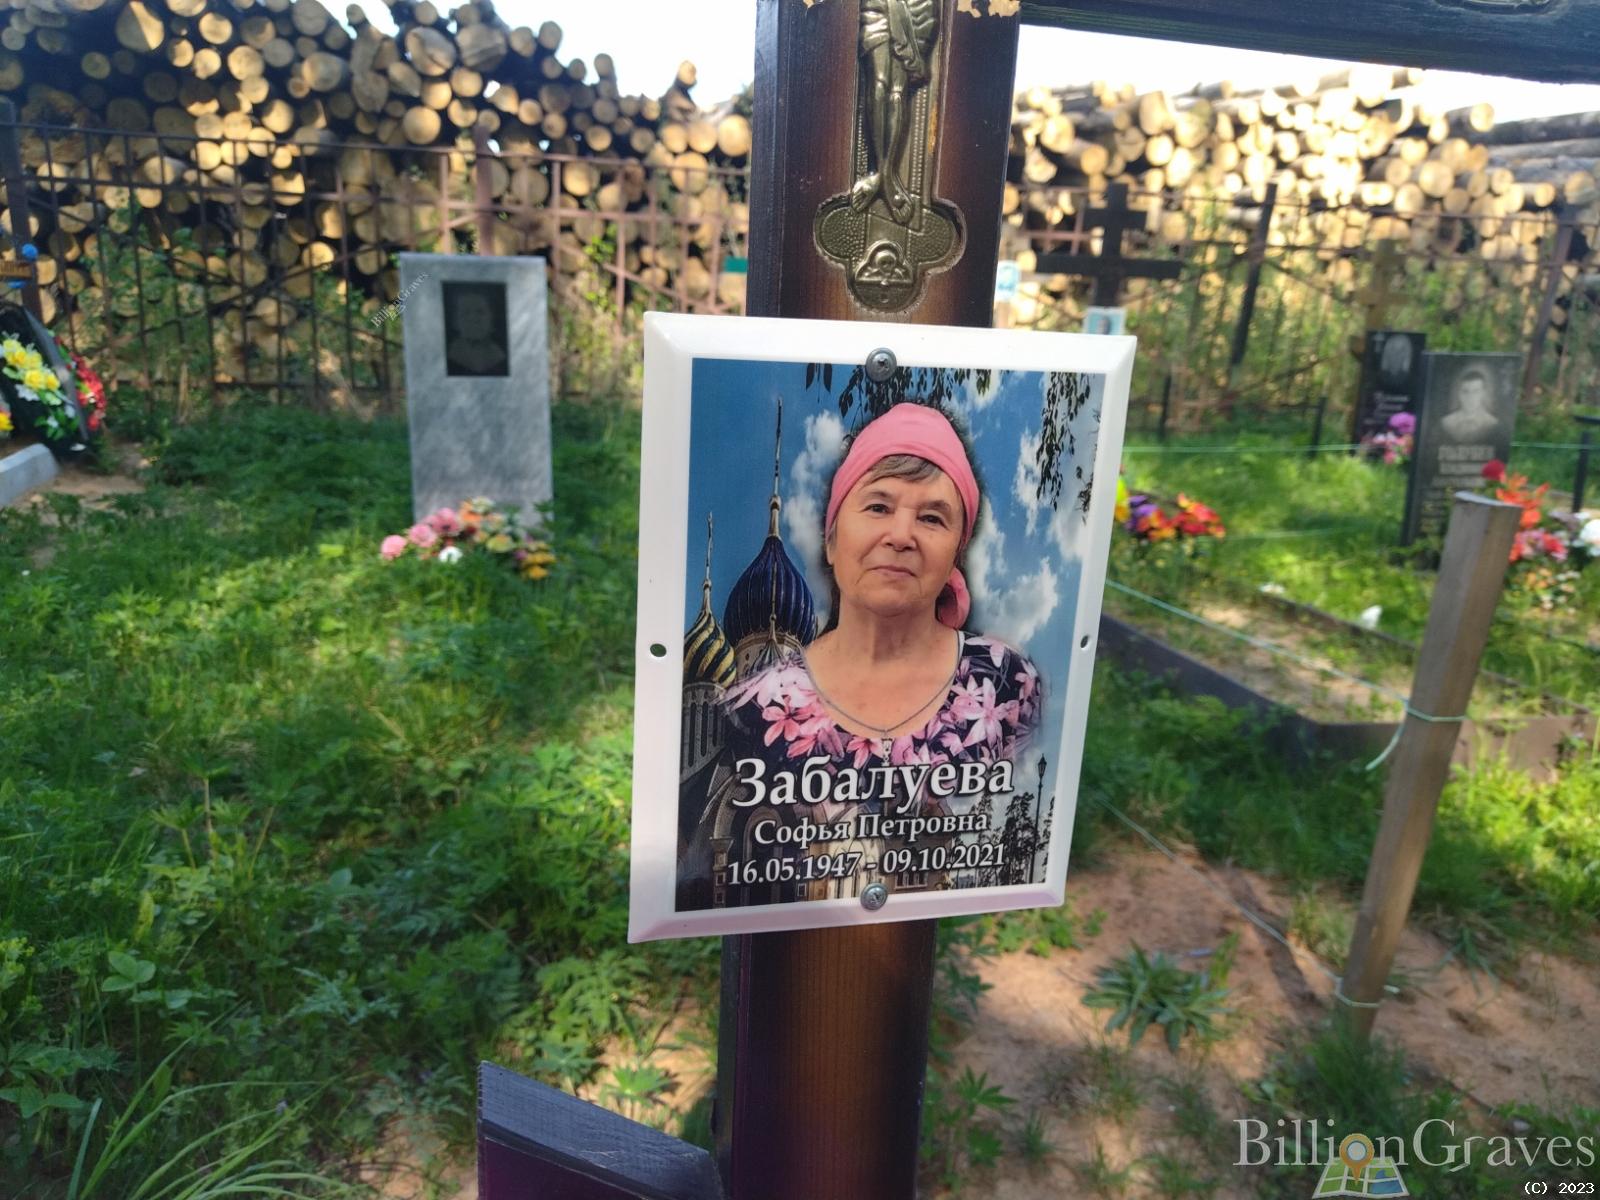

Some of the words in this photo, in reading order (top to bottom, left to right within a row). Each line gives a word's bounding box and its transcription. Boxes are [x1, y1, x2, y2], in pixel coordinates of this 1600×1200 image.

[732, 754, 1015, 813] Забалуева
[754, 818, 849, 850] Софья
[857, 811, 989, 842] Петровна
[728, 851, 862, 885] 16.05.1947
[883, 842, 1006, 874] 09.10.2021
